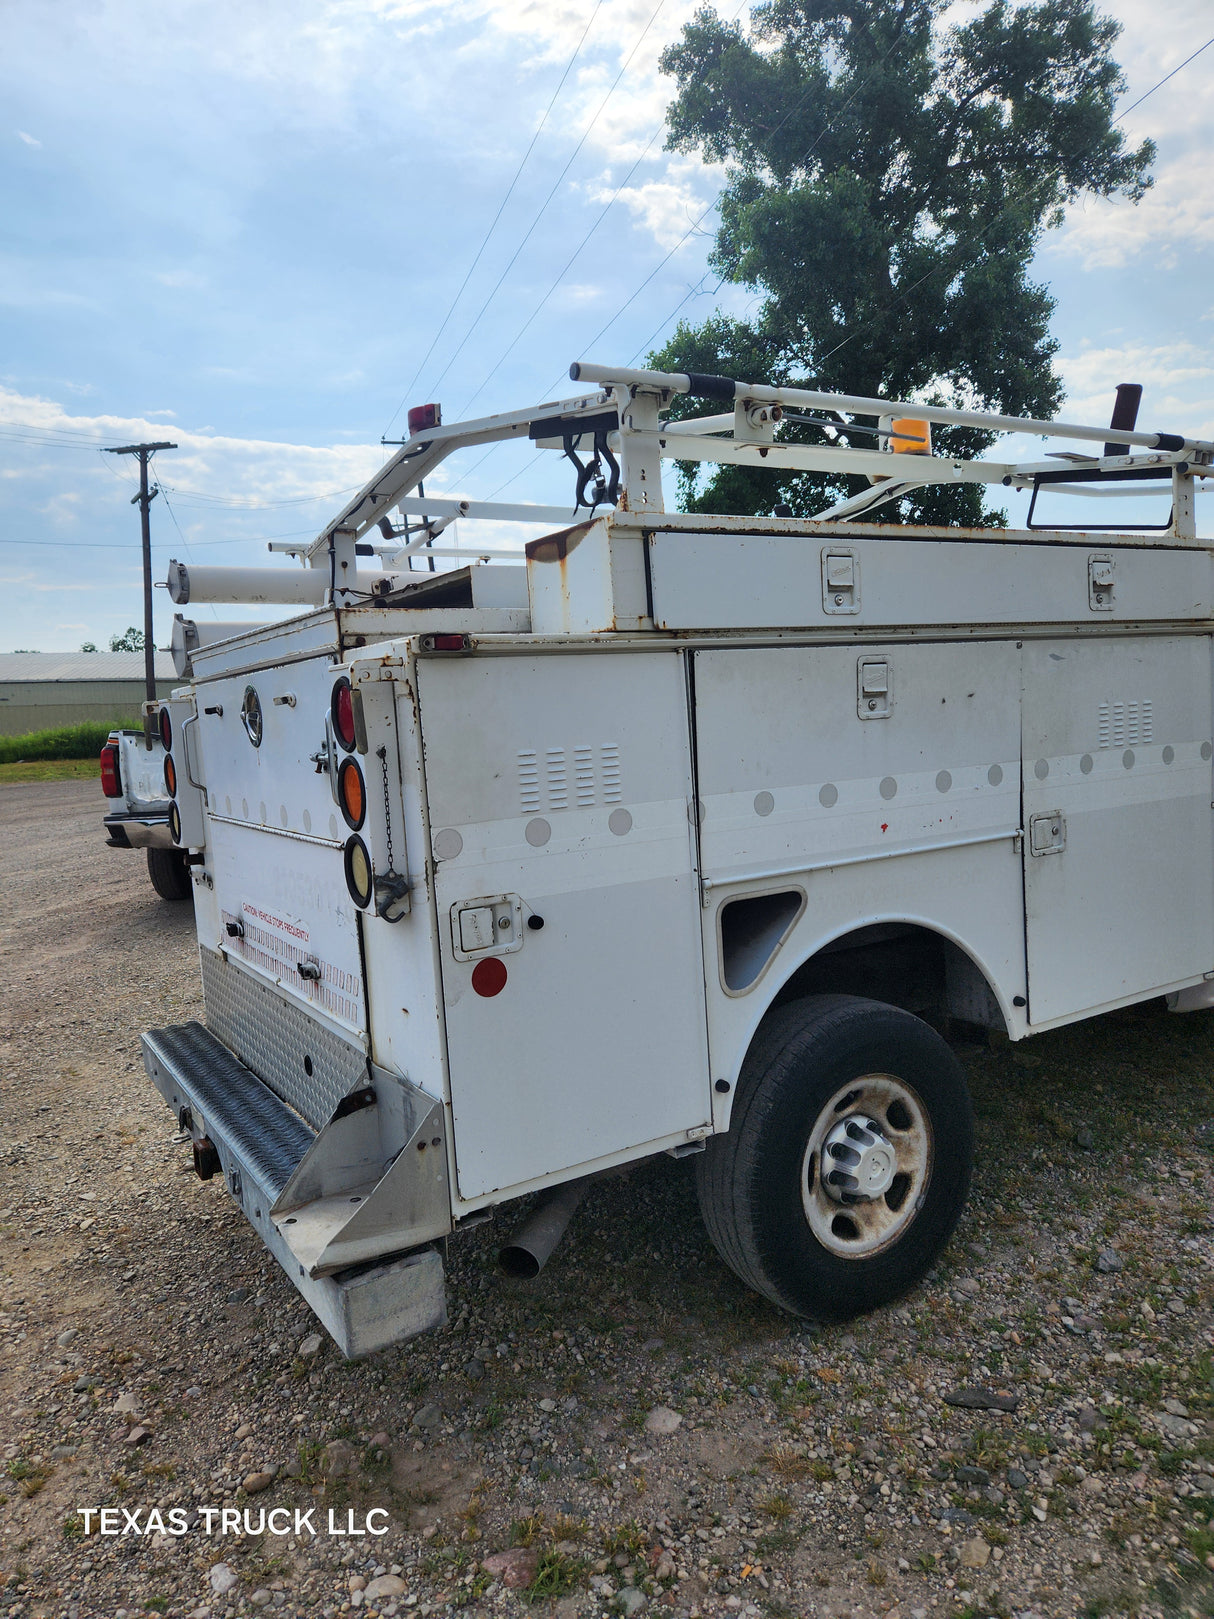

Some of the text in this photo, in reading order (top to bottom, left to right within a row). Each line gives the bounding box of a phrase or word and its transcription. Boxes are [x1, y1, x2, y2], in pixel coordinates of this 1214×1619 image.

[258, 910, 272, 925] VEHICLE
[272, 916, 284, 931] STOPS
[284, 922, 309, 942] FREQUENTLY
